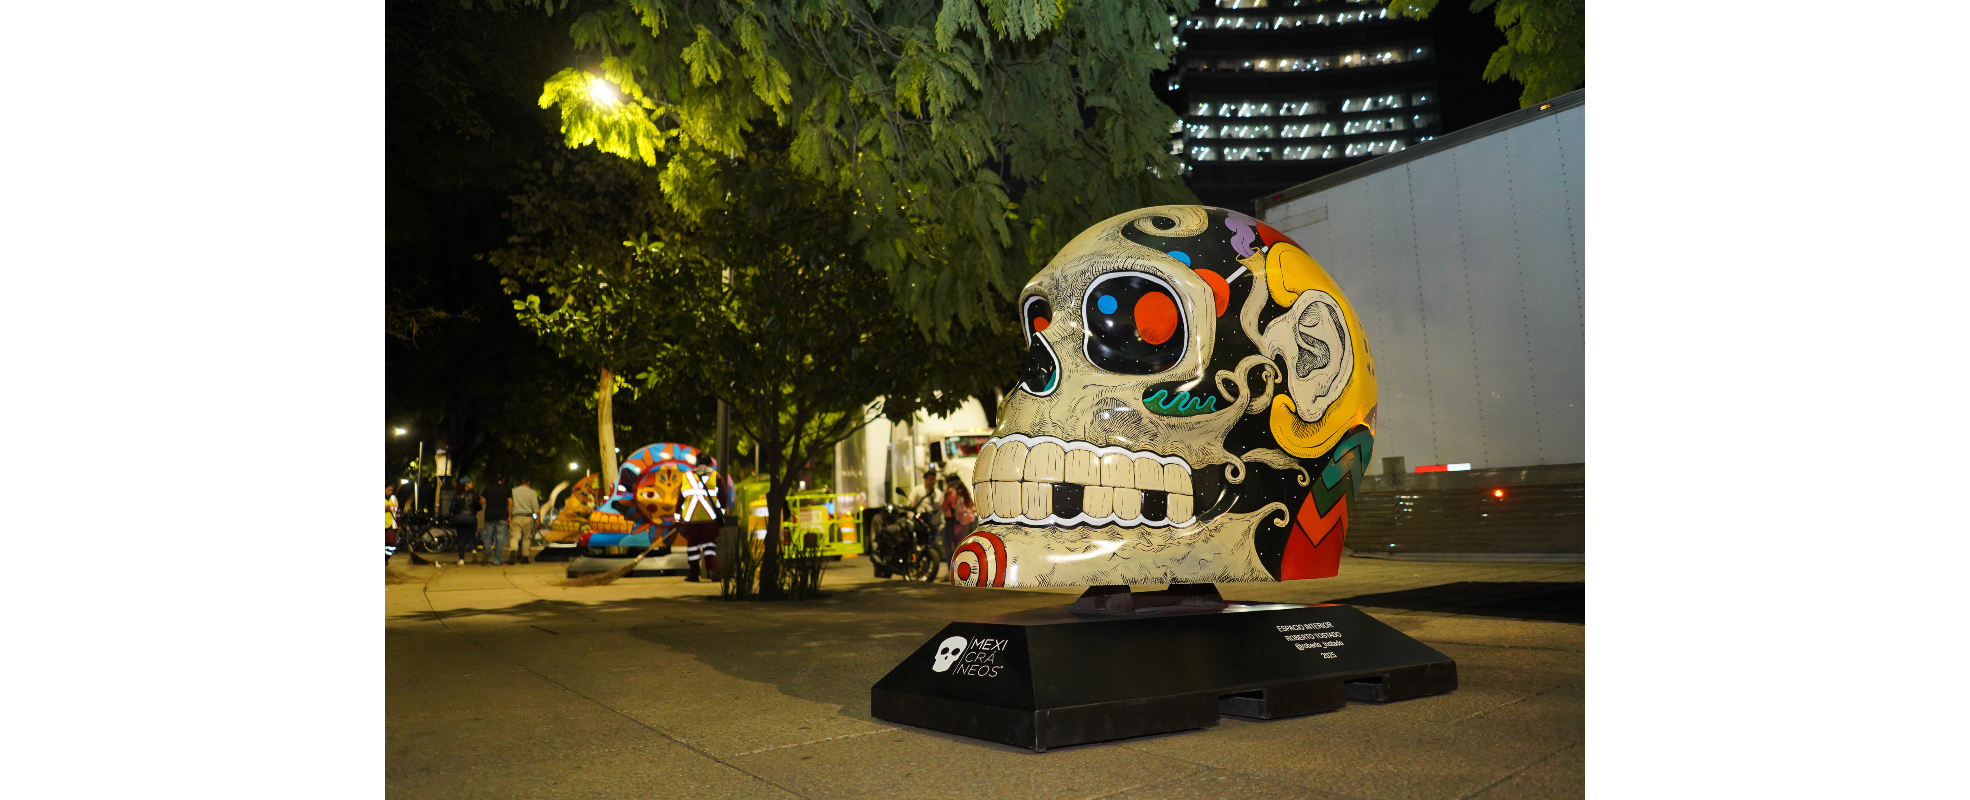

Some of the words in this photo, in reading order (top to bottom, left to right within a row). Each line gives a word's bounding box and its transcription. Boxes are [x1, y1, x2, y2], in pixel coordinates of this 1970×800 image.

[1314, 631, 1342, 639] TOSTADO
[970, 639, 1008, 650] MEXI
[965, 651, 997, 664] CRÁ
